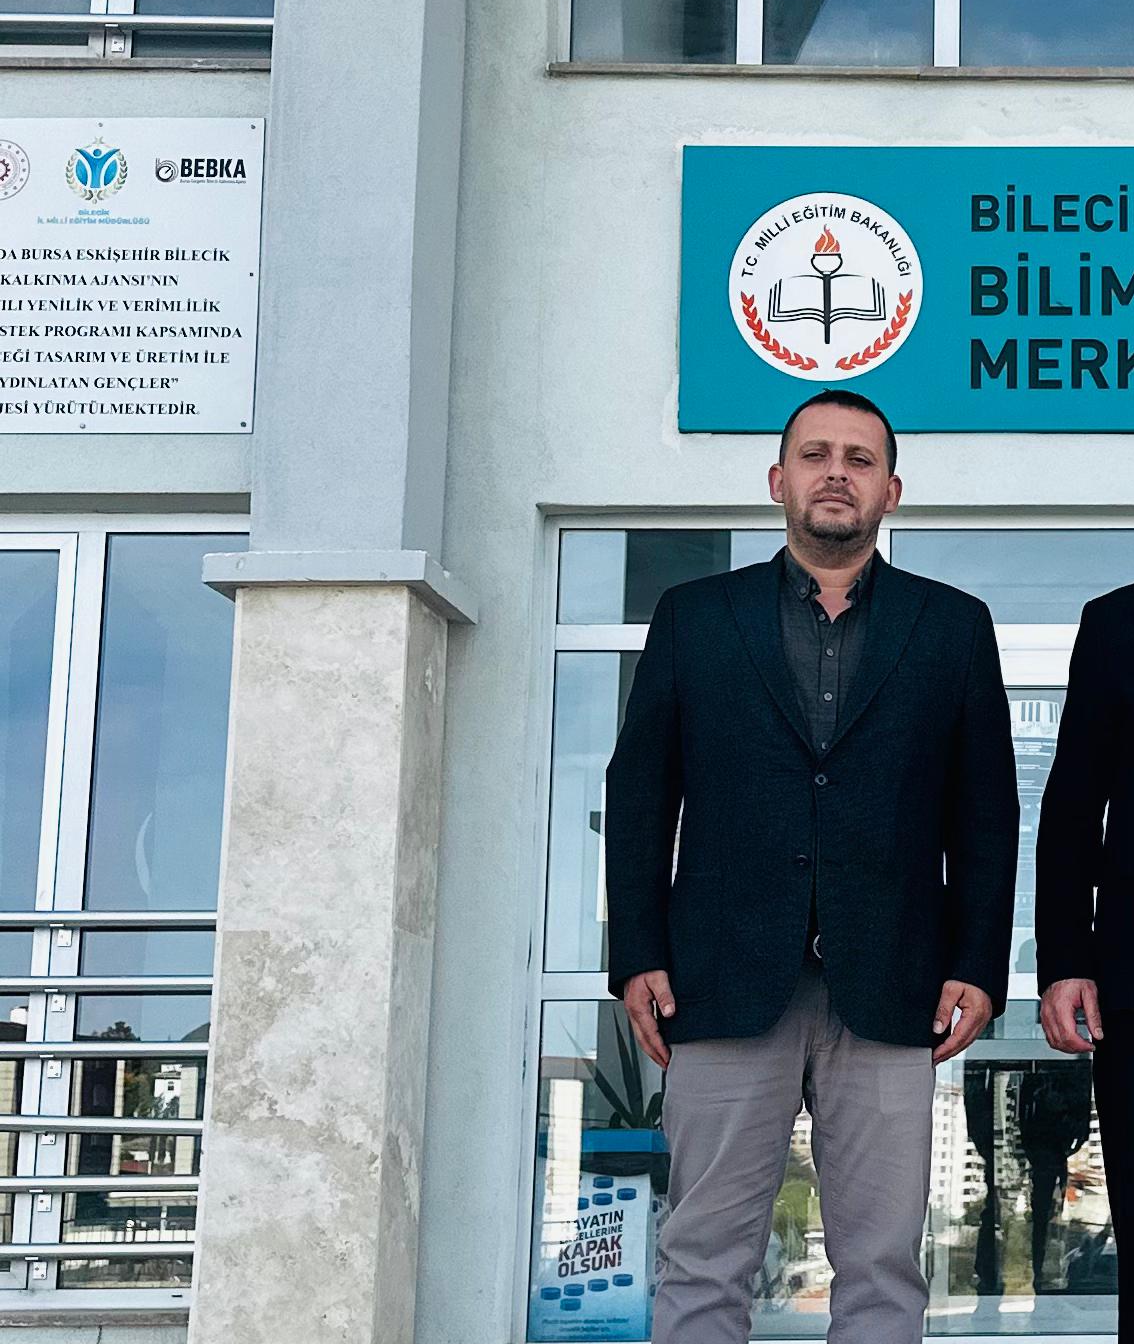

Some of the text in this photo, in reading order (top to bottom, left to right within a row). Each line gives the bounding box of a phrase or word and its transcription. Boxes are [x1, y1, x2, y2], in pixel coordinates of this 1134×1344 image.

[181, 158, 246, 178] BEBKA
[754, 214, 791, 251] MİLLİ
[792, 203, 846, 224] EĞİTİM
[850, 211, 911, 277] BAKANLIĞI
[21, 248, 72, 261] BURSA
[76, 246, 161, 263] ESKİŞEHİR
[164, 246, 231, 262] BİLECİK
[0, 274, 179, 287] KALKINMA AJANSI'NIN
[27, 297, 94, 312] YENİLİK
[98, 300, 119, 312] VE
[122, 297, 221, 313] VERİMLİLİK
[44, 325, 131, 338] PROGRAMI
[136, 325, 242, 338] KAPSAMINDA
[34, 351, 106, 363] TASARIM
[110, 351, 131, 363] VE
[136, 348, 199, 364] ÜRETİM
[204, 349, 231, 364] İLE
[33, 399, 200, 415] YÜRÜTÜLMEKTEDİR.
[558, 1233, 623, 1262] KAPAK
[557, 1250, 622, 1278] OLSUN!
